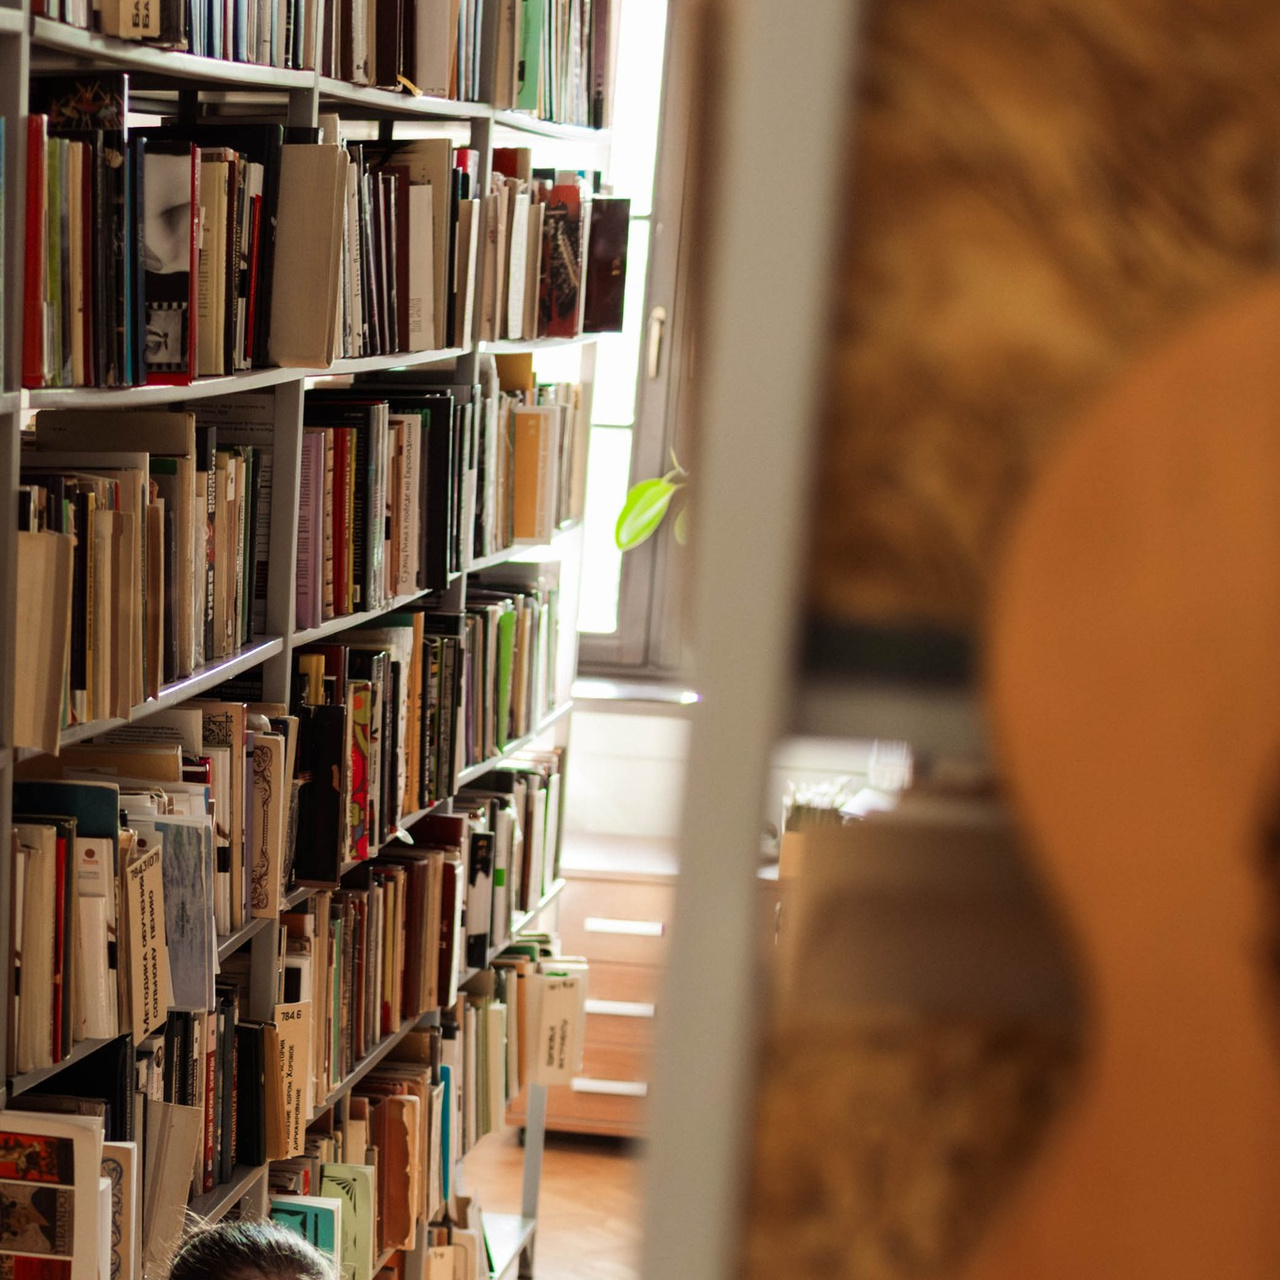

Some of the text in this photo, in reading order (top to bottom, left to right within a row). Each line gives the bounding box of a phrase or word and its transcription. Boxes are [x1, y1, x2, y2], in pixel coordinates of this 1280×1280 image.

[403, 494, 411, 524] победе
[148, 890, 159, 1019] СОЛЬНОМУ ПЕНИЮ
[292, 1088, 302, 1151] ДИРИЖИРОВАНИЕ
